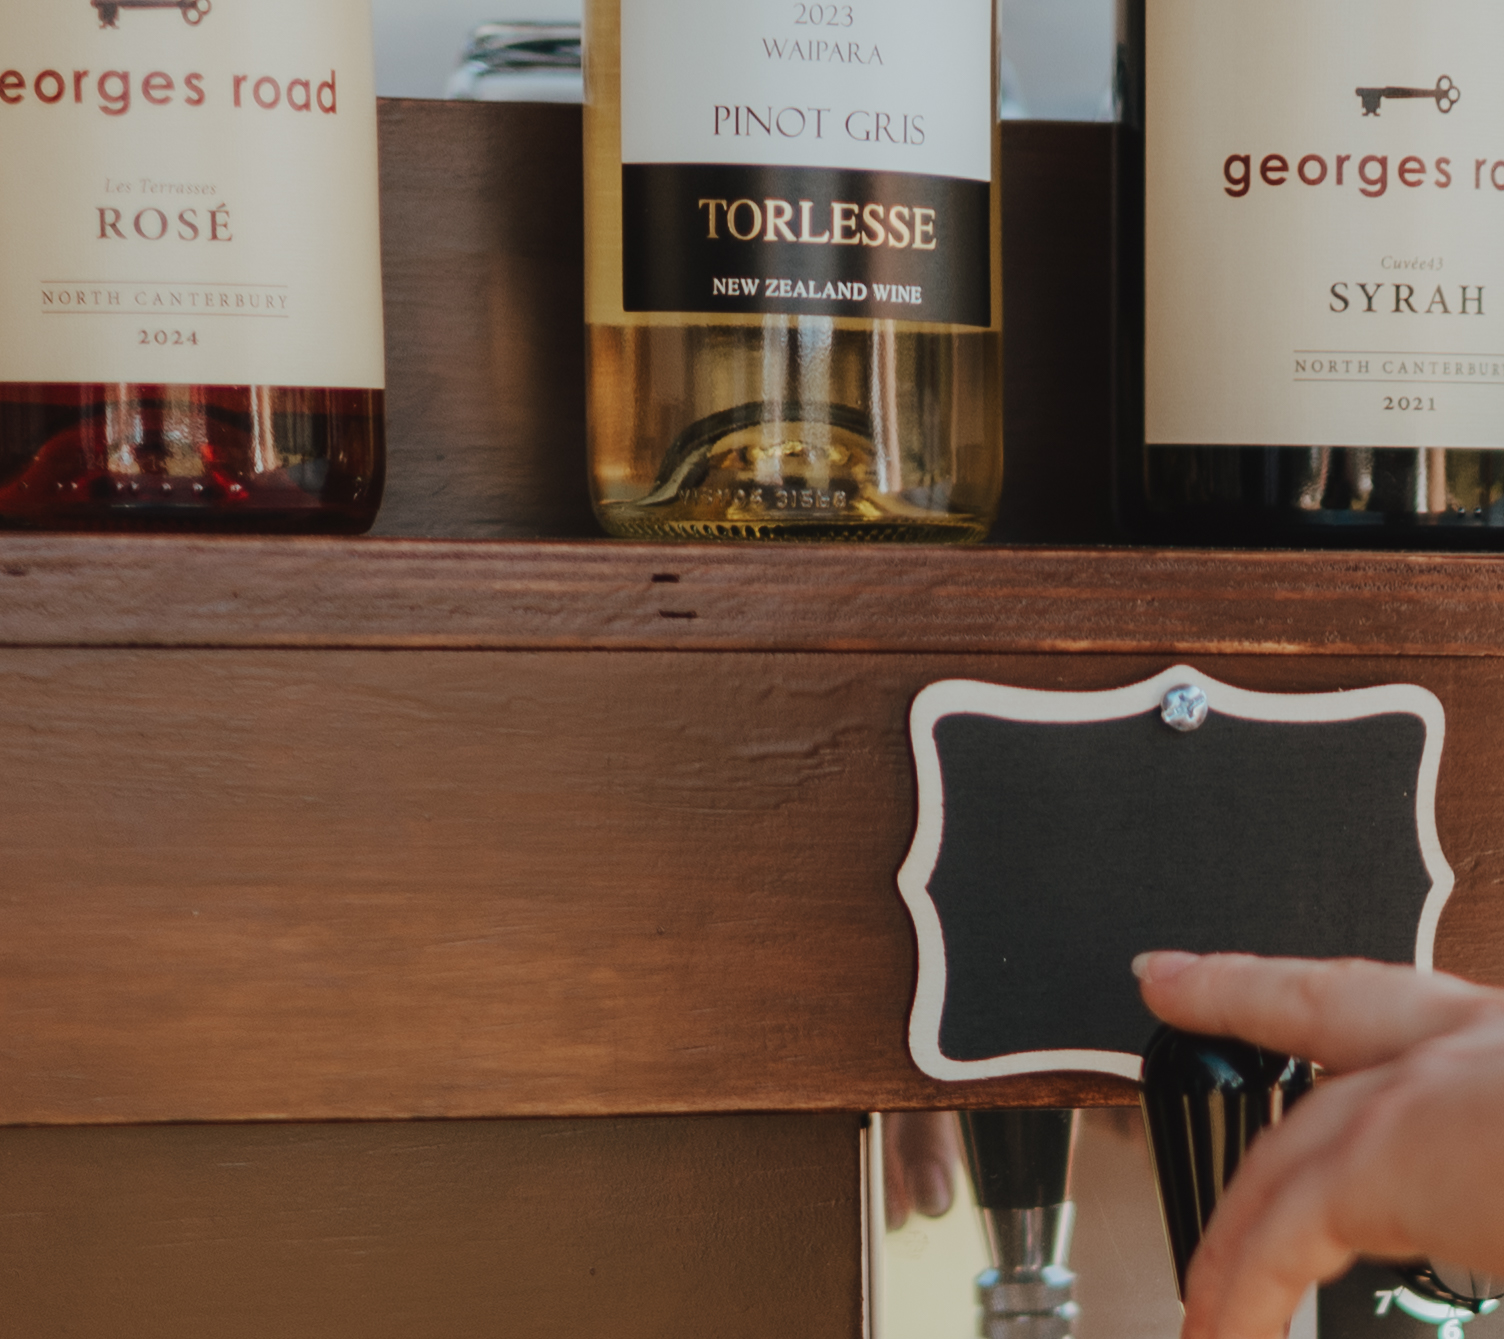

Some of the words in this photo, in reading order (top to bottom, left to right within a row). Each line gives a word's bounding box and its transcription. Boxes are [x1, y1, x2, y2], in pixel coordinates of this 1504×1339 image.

[794, 4, 854, 27] 2023
[762, 37, 884, 66] WAIPARA
[232, 70, 338, 114] road
[713, 105, 831, 139] PINOT
[845, 111, 927, 146] GRIS
[139, 178, 218, 197] Terrasses
[1223, 153, 1453, 198] georges
[96, 203, 234, 243] ROSÉ
[698, 199, 937, 251] TORLESSE
[41, 290, 122, 306] NORTH
[134, 290, 289, 310] CANTERBURY
[712, 277, 760, 297] NEW
[765, 278, 867, 302] ZEALAND
[872, 283, 923, 304] WINE
[1329, 281, 1486, 316] SYRAH
[137, 329, 200, 346] 2024
[1294, 359, 1371, 374] NORTH
[1382, 396, 1437, 412] 2021
[1374, 1289, 1394, 1316] 7
